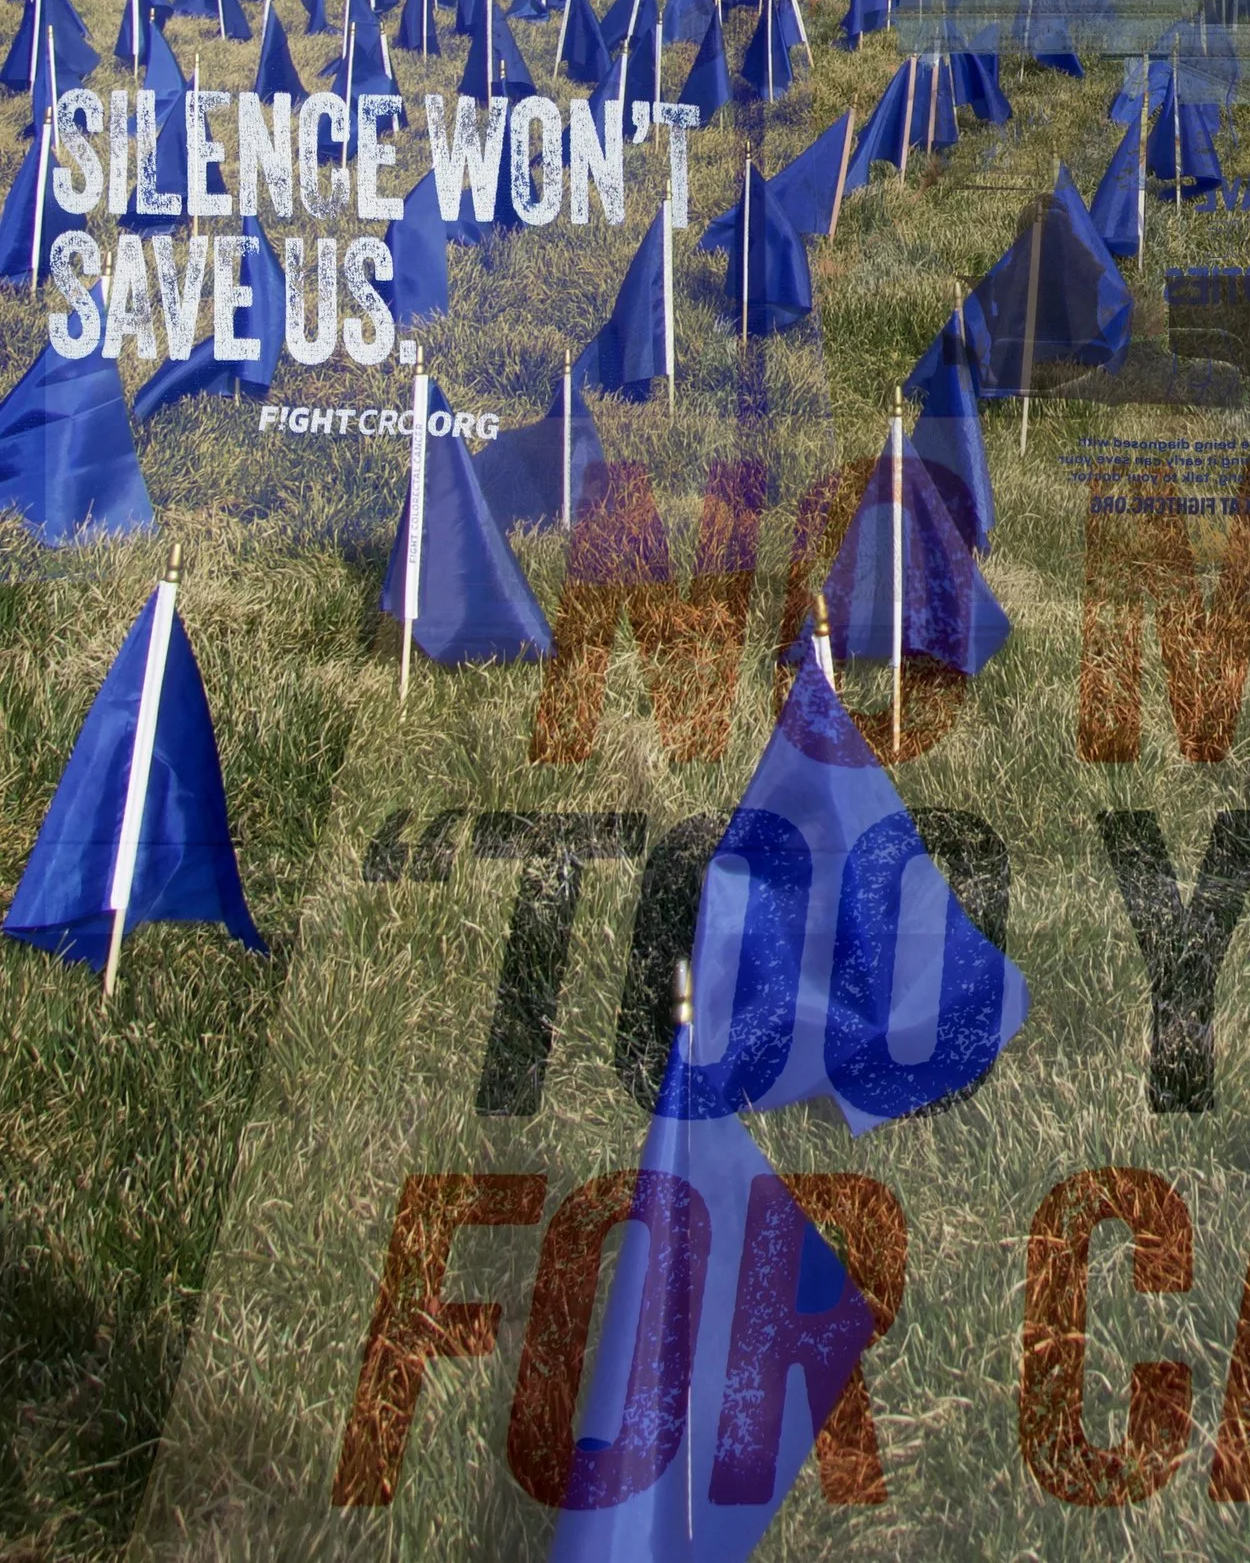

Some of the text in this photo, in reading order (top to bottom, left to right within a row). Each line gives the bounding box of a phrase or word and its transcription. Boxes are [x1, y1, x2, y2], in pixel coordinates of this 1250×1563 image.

[52, 88, 699, 228] SILENCE WON'T
[48, 230, 417, 366] SAVE US.
[531, 455, 969, 763] NO
[331, 1170, 909, 1510] FOR
